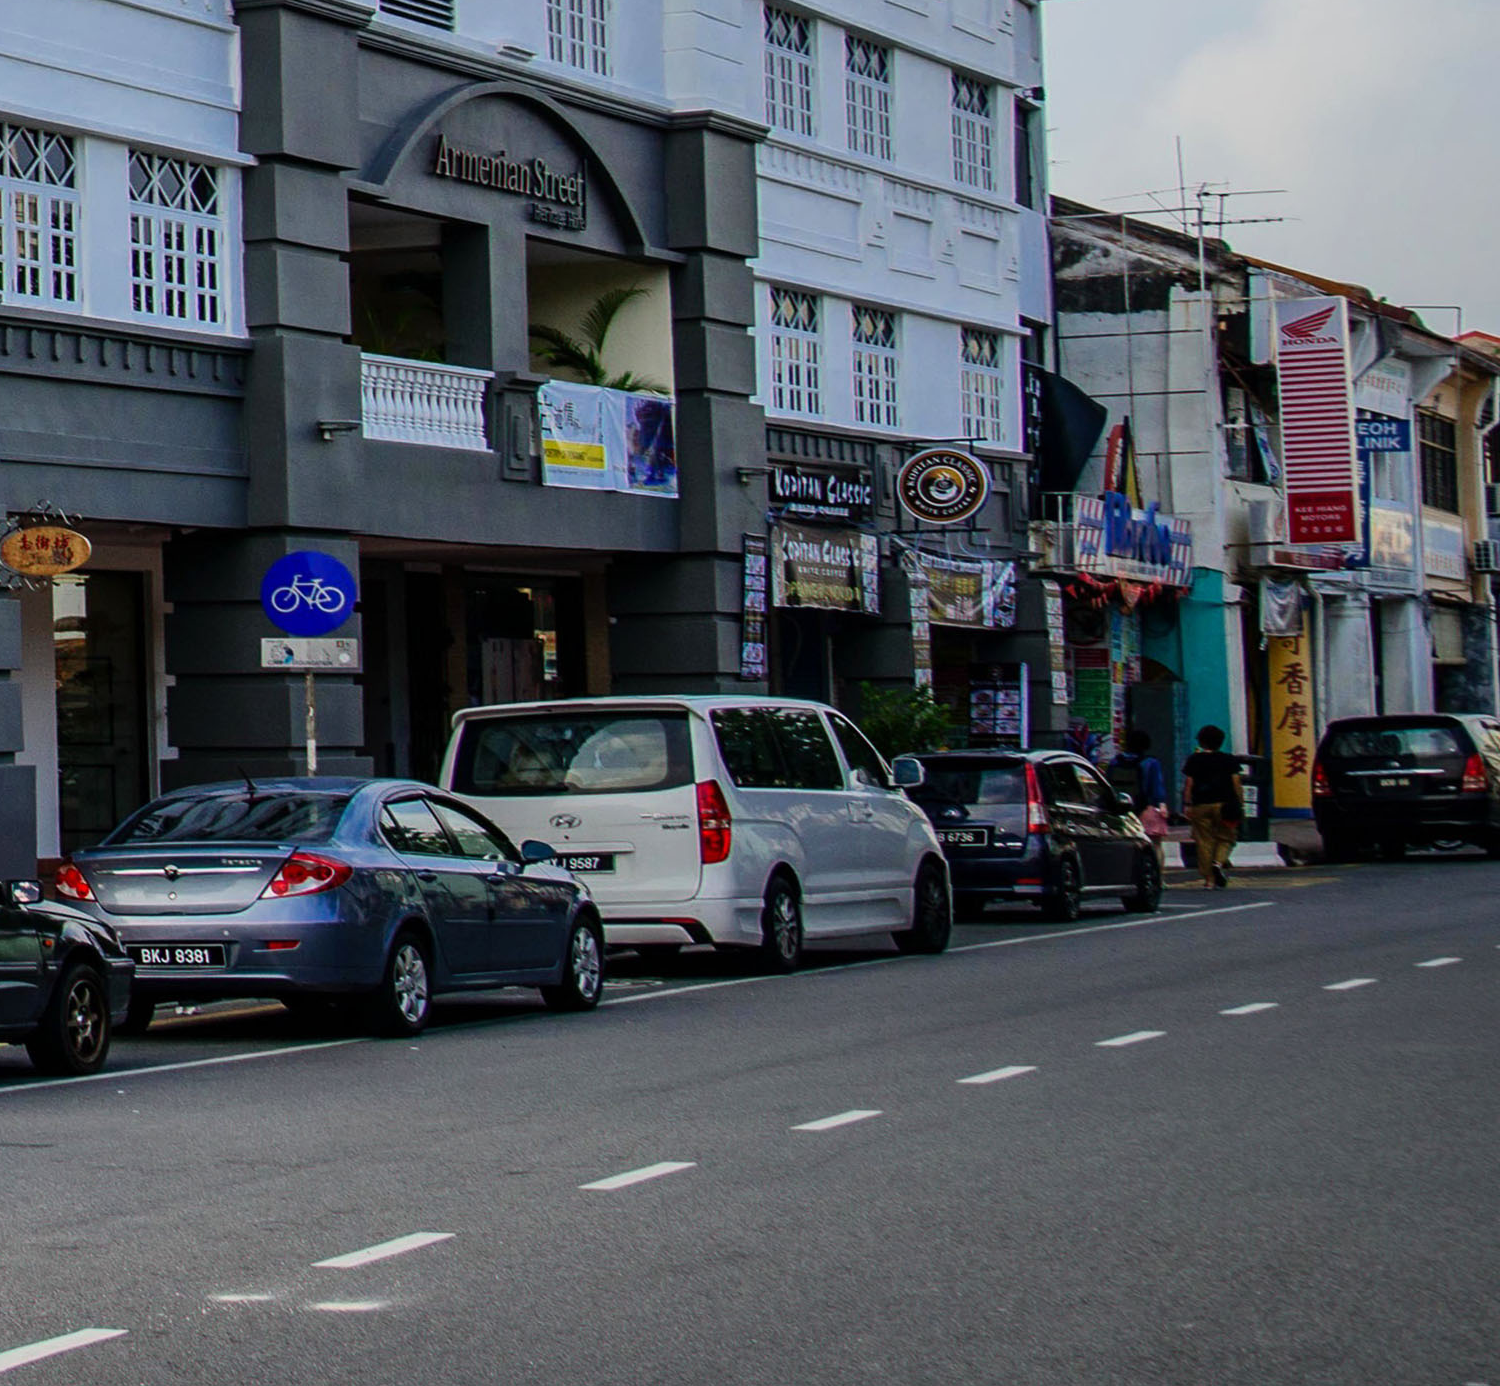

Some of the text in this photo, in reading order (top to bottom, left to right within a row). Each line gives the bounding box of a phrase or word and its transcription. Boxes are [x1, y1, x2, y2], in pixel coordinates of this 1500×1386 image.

[435, 133, 585, 206] Armenian Street
[1281, 336, 1339, 347] HONDA
[1356, 422, 1398, 436] EOH
[907, 456, 977, 487] KOPITAN CLASSIC
[1299, 513, 1342, 522] MOTORS
[947, 832, 975, 842] 6736
[569, 857, 600, 869] 9587
[140, 948, 210, 964] BKJ 8381
